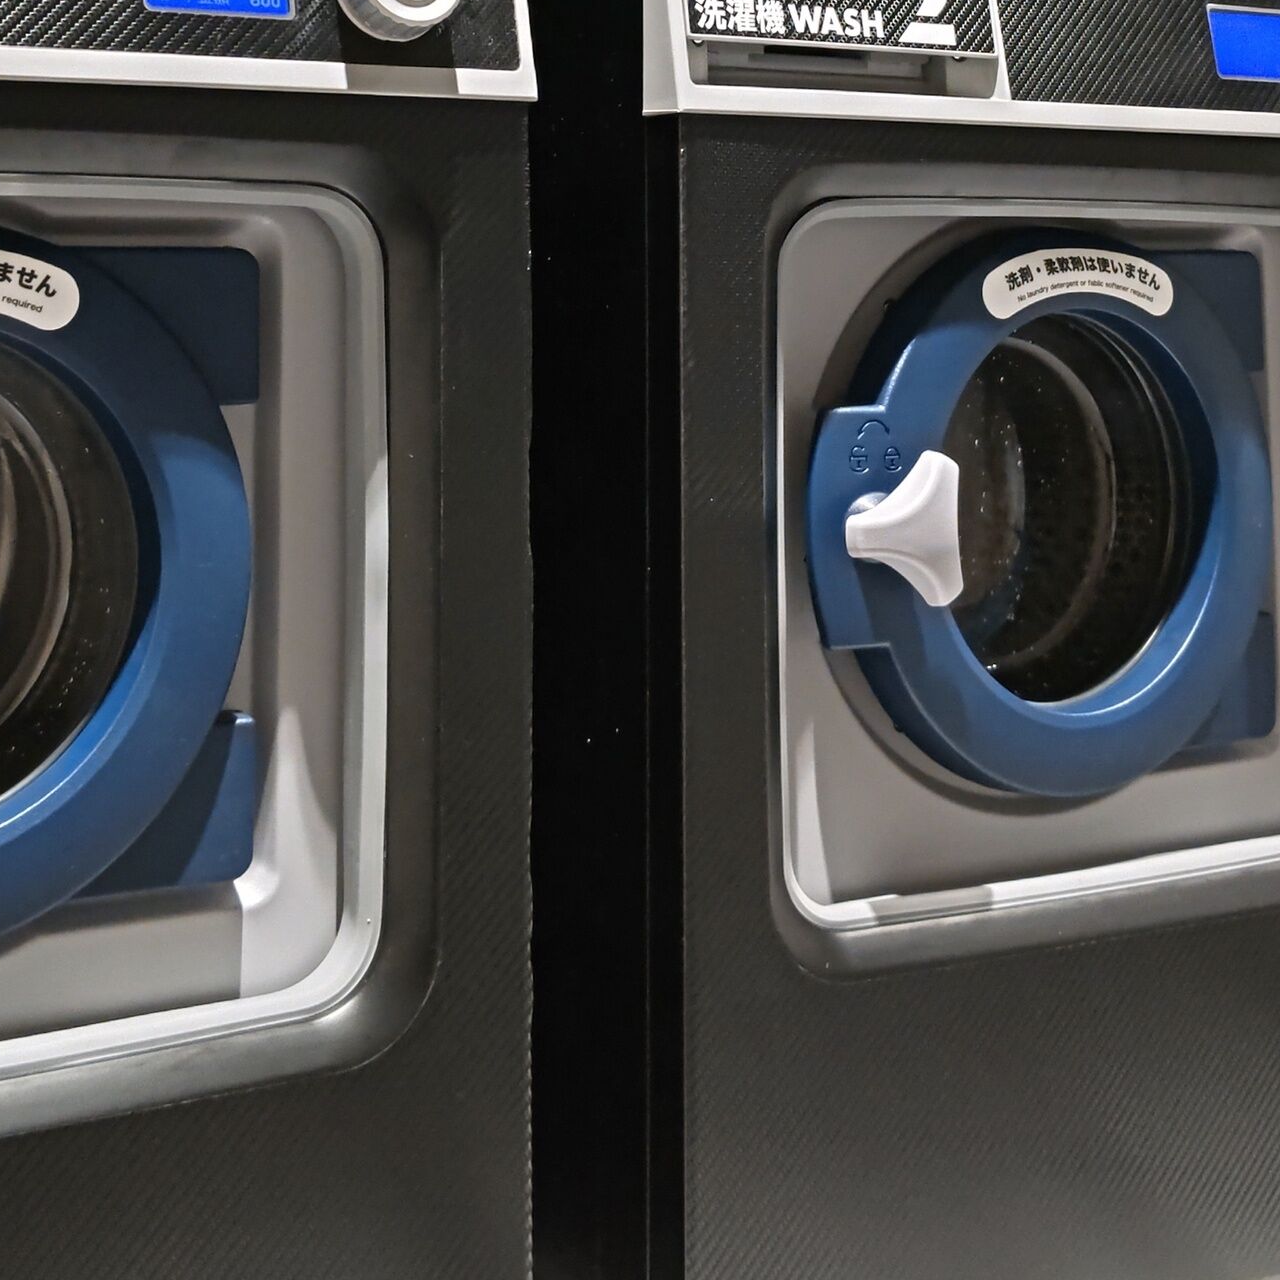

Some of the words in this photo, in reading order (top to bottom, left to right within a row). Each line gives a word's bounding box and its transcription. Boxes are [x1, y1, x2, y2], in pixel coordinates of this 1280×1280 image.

[787, 3, 885, 38] WASH
[1005, 256, 1160, 291] 洗剤・柔軟剤は使いません
[2, 295, 43, 313] required
[1027, 286, 1049, 298] laundry
[1050, 280, 1079, 290] detergent
[1130, 287, 1154, 302] required
